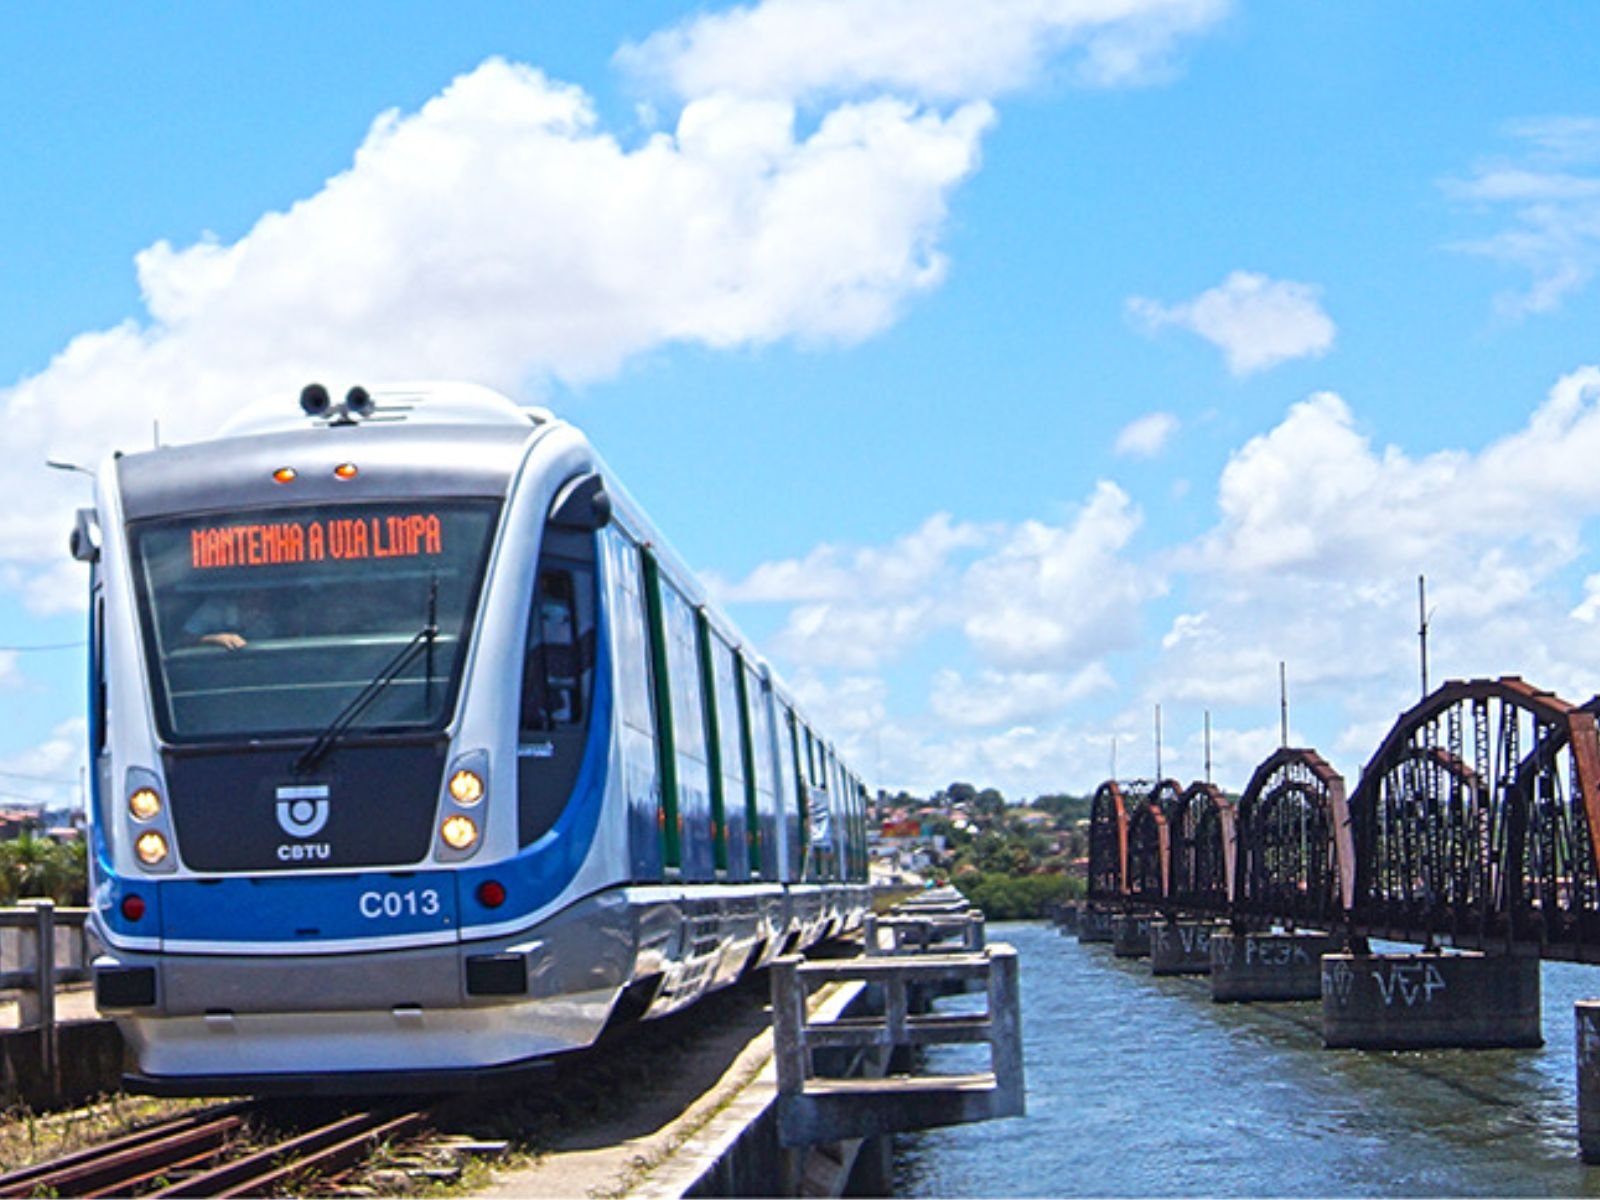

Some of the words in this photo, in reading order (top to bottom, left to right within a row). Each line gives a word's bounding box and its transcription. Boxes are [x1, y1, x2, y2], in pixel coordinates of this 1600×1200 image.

[309, 521, 324, 560] A
[328, 518, 368, 558] VIA
[373, 513, 442, 557] LIMPA
[277, 843, 330, 861] CBTU
[359, 889, 440, 918] C013
